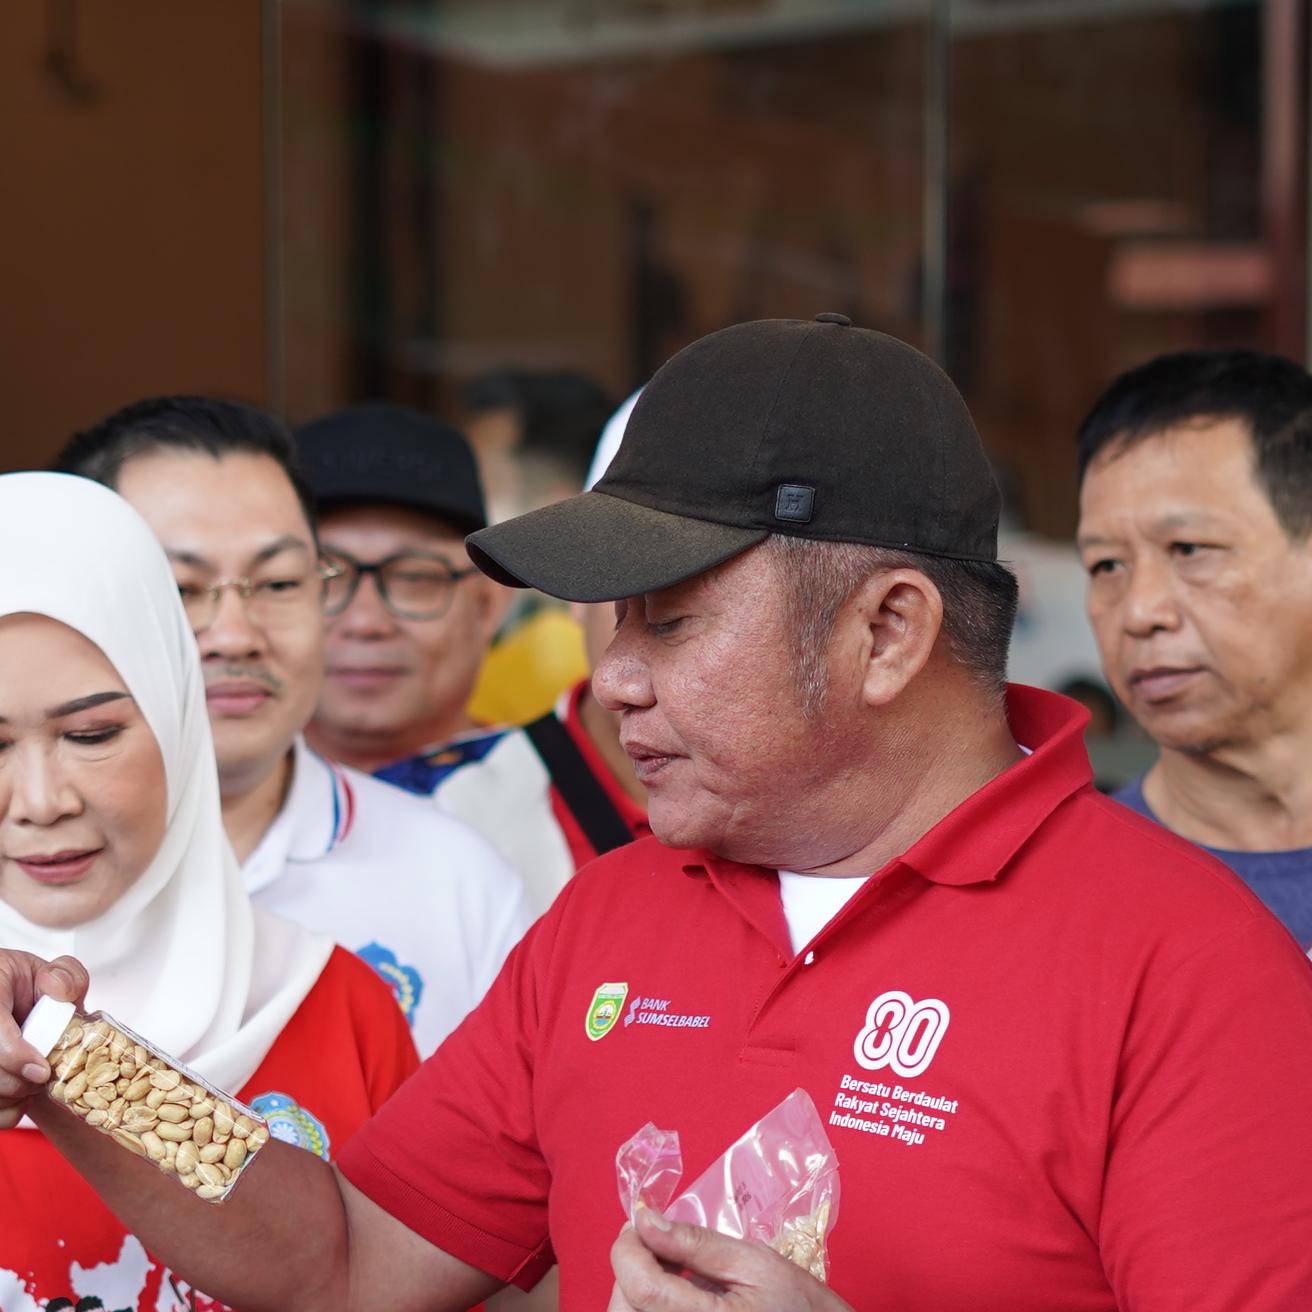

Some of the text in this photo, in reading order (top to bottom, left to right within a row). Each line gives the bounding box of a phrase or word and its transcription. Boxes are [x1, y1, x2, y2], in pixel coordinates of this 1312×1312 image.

[636, 1012, 711, 1028] SUMSELBABEL
[640, 997, 672, 1012] BANK
[853, 990, 951, 1078] 80
[834, 1092, 946, 1131] Rakyat Sejahtera
[840, 1074, 959, 1114] Bersatu Berdaulat
[828, 1110, 925, 1146] Indonesia Maju
